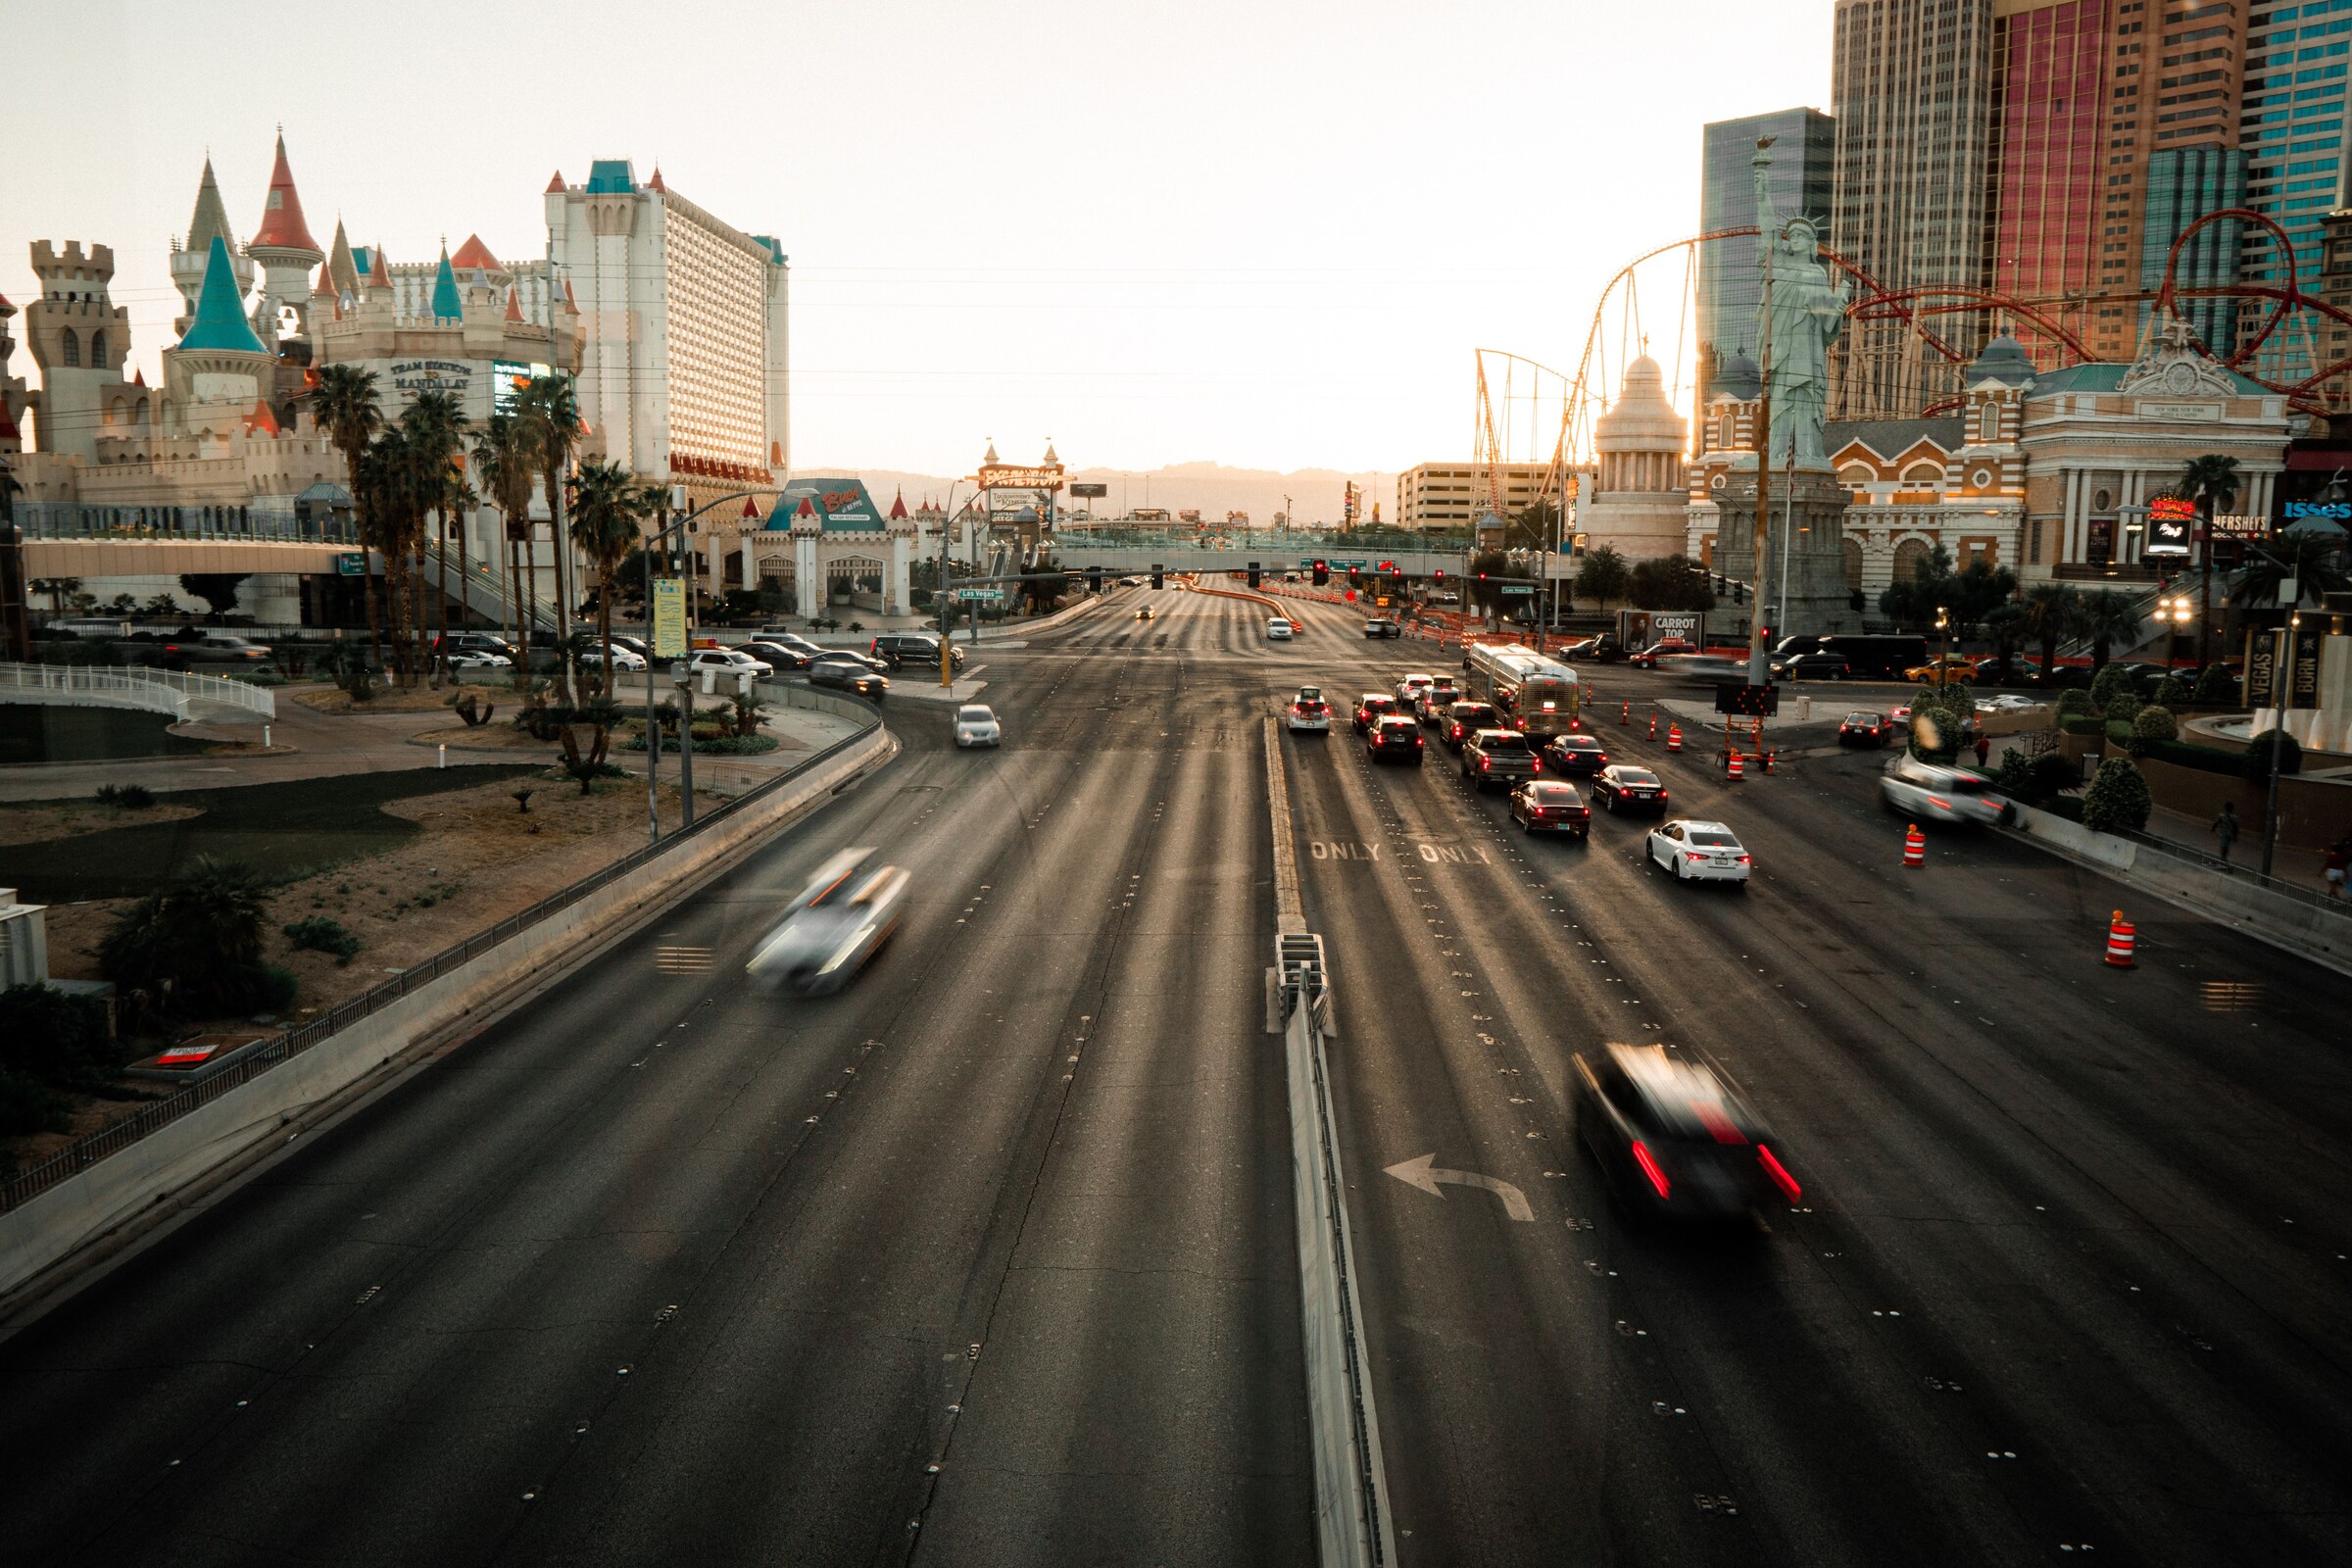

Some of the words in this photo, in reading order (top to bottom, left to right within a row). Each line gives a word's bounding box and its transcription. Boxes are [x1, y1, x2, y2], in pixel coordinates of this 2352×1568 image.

[391, 362, 422, 374] TRAM
[424, 361, 471, 375] STATION
[395, 378, 468, 389] MANDALAY
[985, 468, 1058, 486] EXCALIBUR
[661, 595, 680, 612] LAS
[1655, 617, 1695, 628] CARROT
[661, 618, 681, 650] VEGAS
[1664, 628, 1685, 638] TOP
[2251, 654, 2272, 695] VEGAS
[2296, 659, 2316, 693] BORN
[1310, 842, 1380, 860] ONLY
[1418, 844, 1491, 865] ONLY
